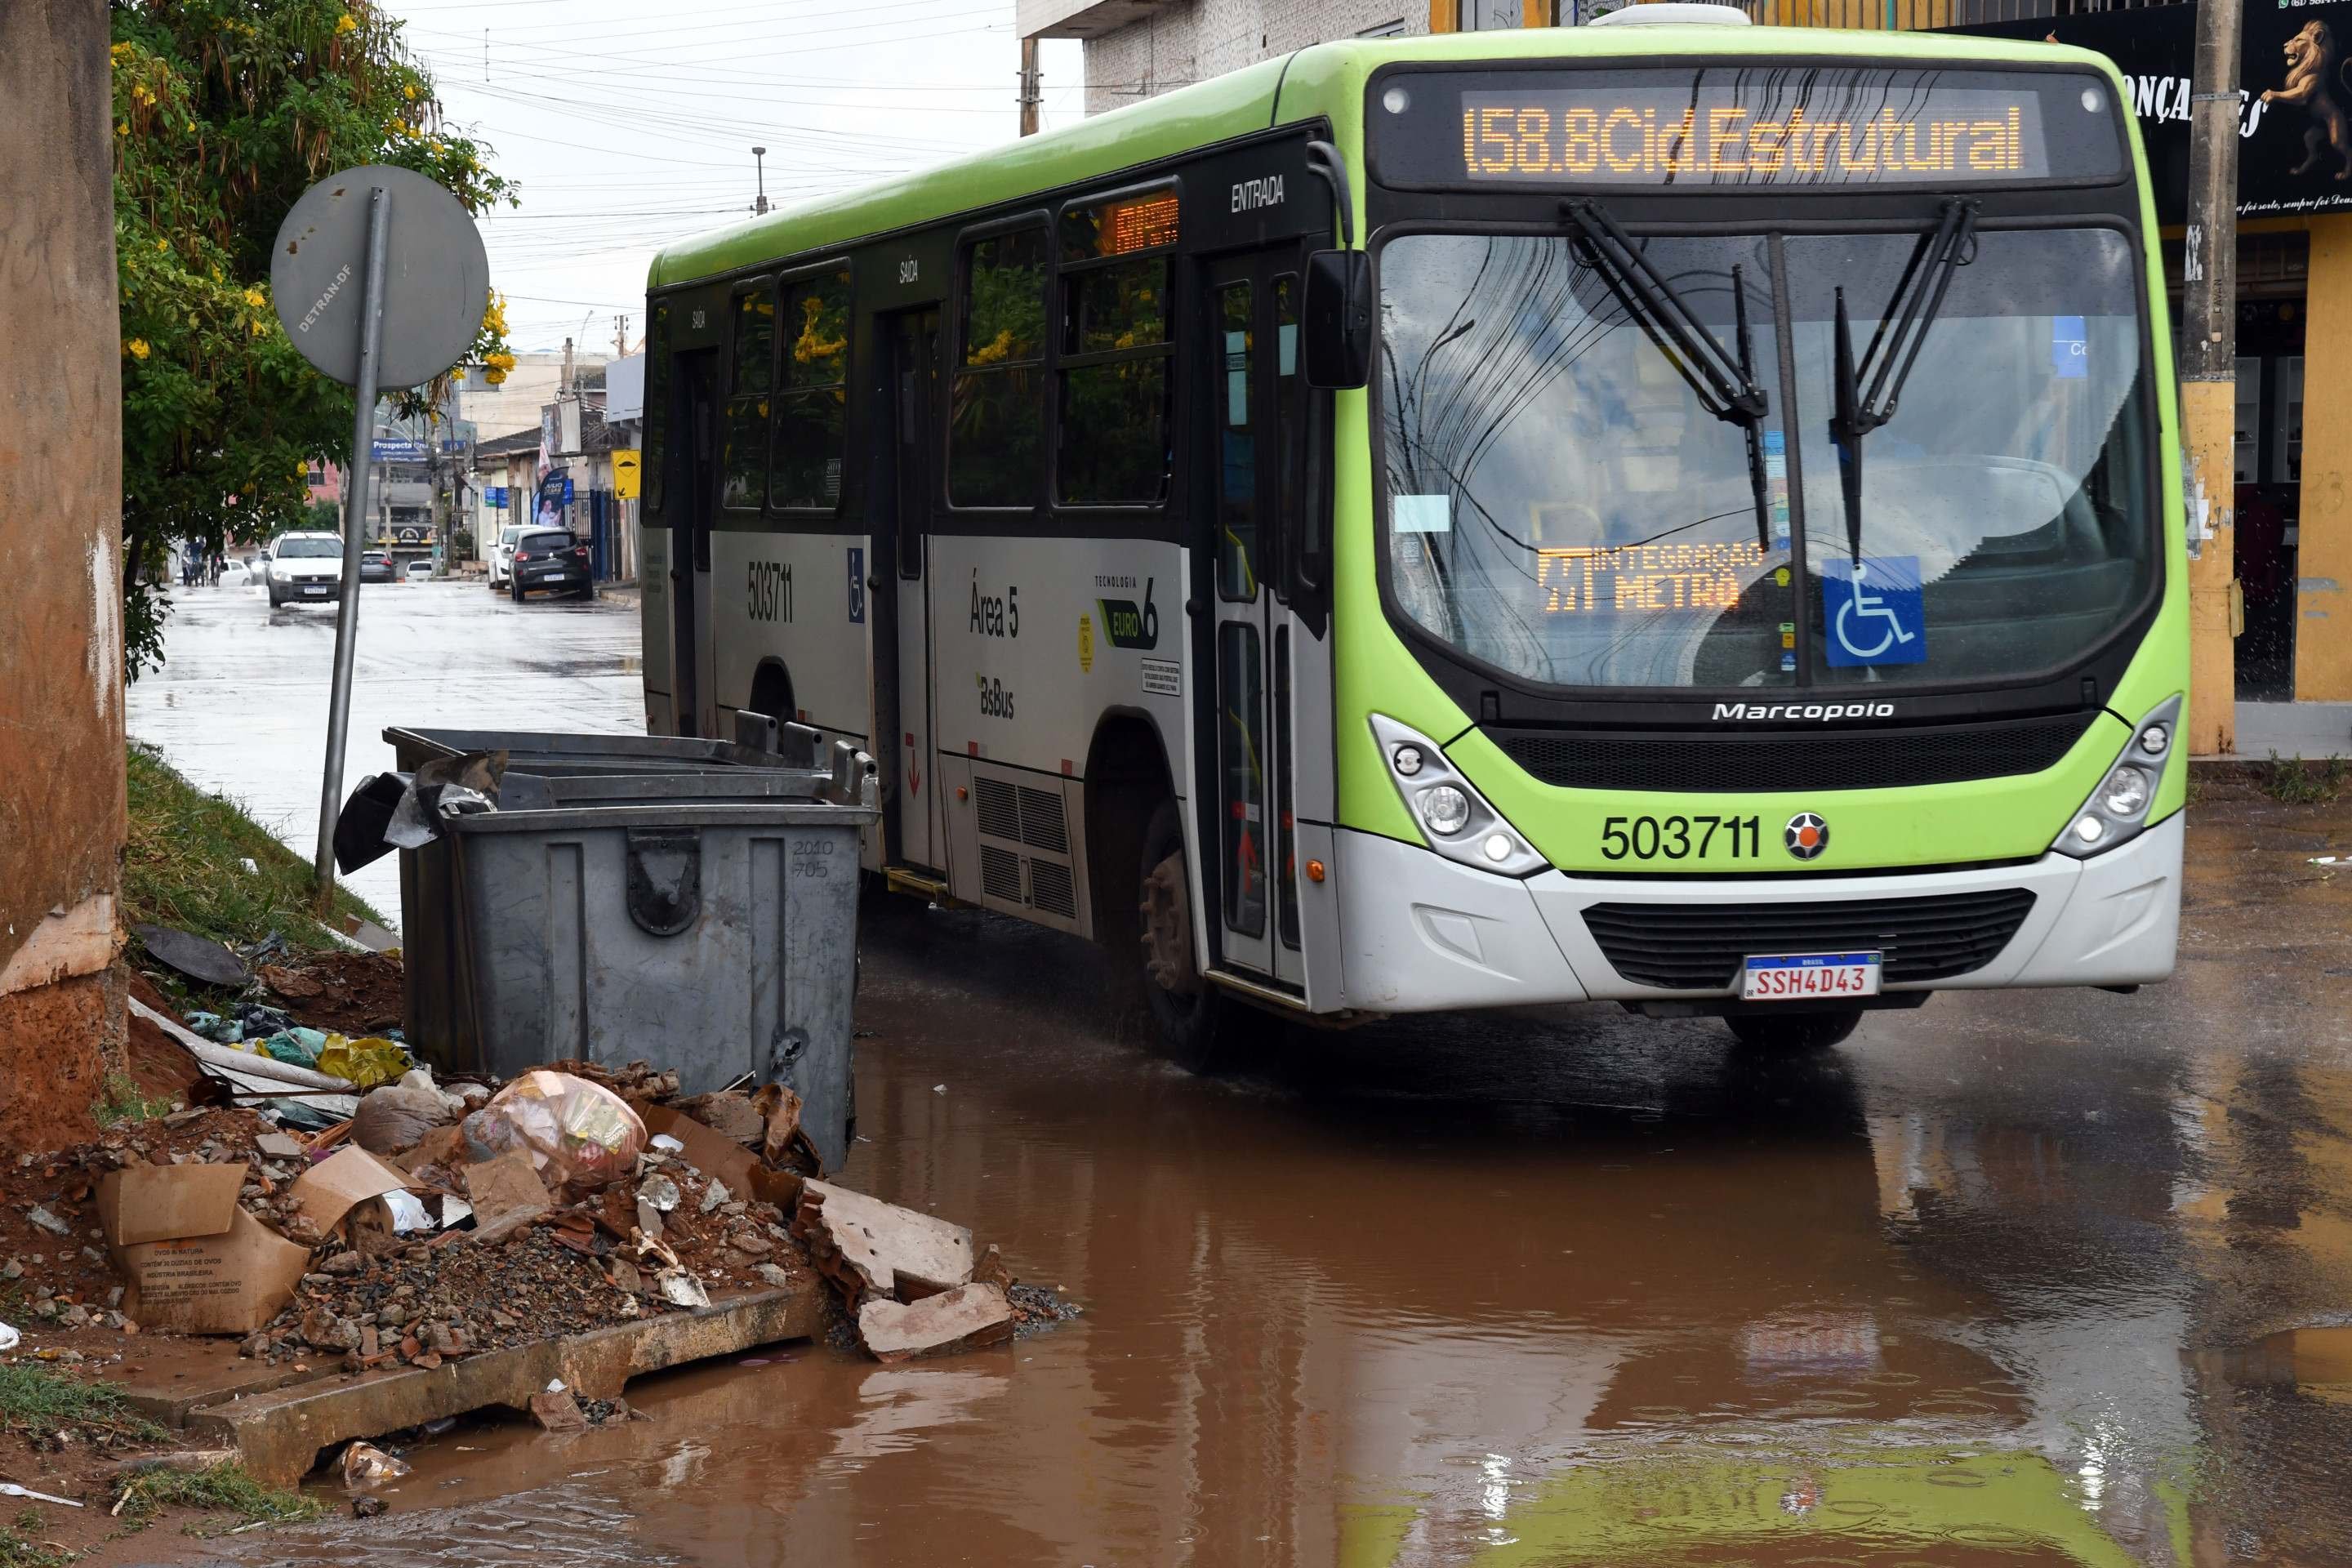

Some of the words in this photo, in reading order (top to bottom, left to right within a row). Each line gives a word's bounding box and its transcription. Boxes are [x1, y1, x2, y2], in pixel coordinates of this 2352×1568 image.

[1232, 174, 1285, 213] ENTRADA
[899, 254, 918, 284] SAÍDA
[299, 264, 350, 332] DETRAN-DF
[693, 305, 706, 328] SAÍDA
[373, 441, 412, 450] Prospecta
[748, 561, 792, 623] 503711
[1094, 575, 1137, 589] TECNOLOGIA
[970, 567, 1004, 638] Área
[1009, 586, 1018, 638] 5
[1113, 612, 1139, 637] EURO
[1143, 577, 1158, 650] 6
[980, 676, 1014, 720] BsBus
[1712, 701, 1894, 721] Marcopolo
[793, 840, 833, 856] 2010
[1601, 815, 1759, 860] 503711
[793, 860, 828, 878] 705
[1757, 968, 1865, 994] SSH4D43
